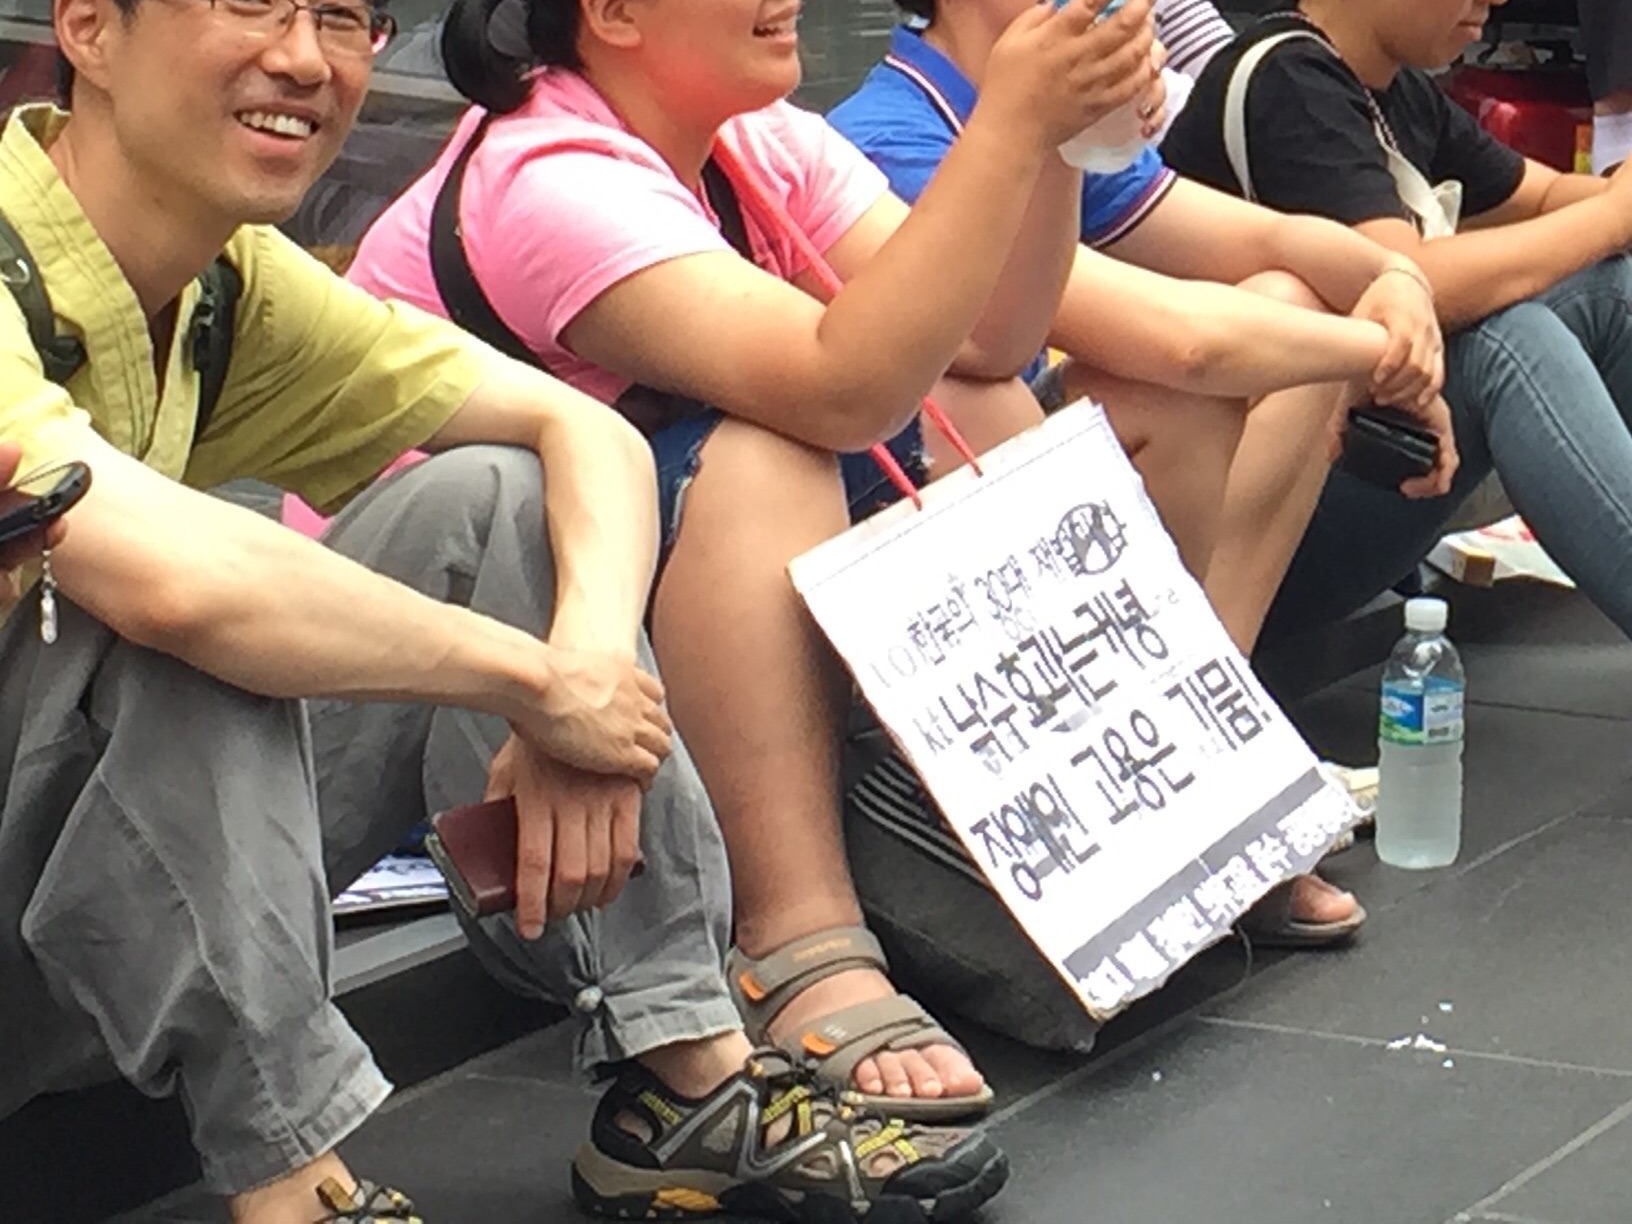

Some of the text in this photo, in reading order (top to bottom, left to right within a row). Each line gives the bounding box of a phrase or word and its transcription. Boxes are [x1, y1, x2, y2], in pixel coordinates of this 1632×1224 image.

[907, 583, 979, 665] 한국의
[969, 772, 1101, 901] 장애인
[1070, 708, 1197, 825] 고용은
[1163, 655, 1272, 750] 가뭄!
